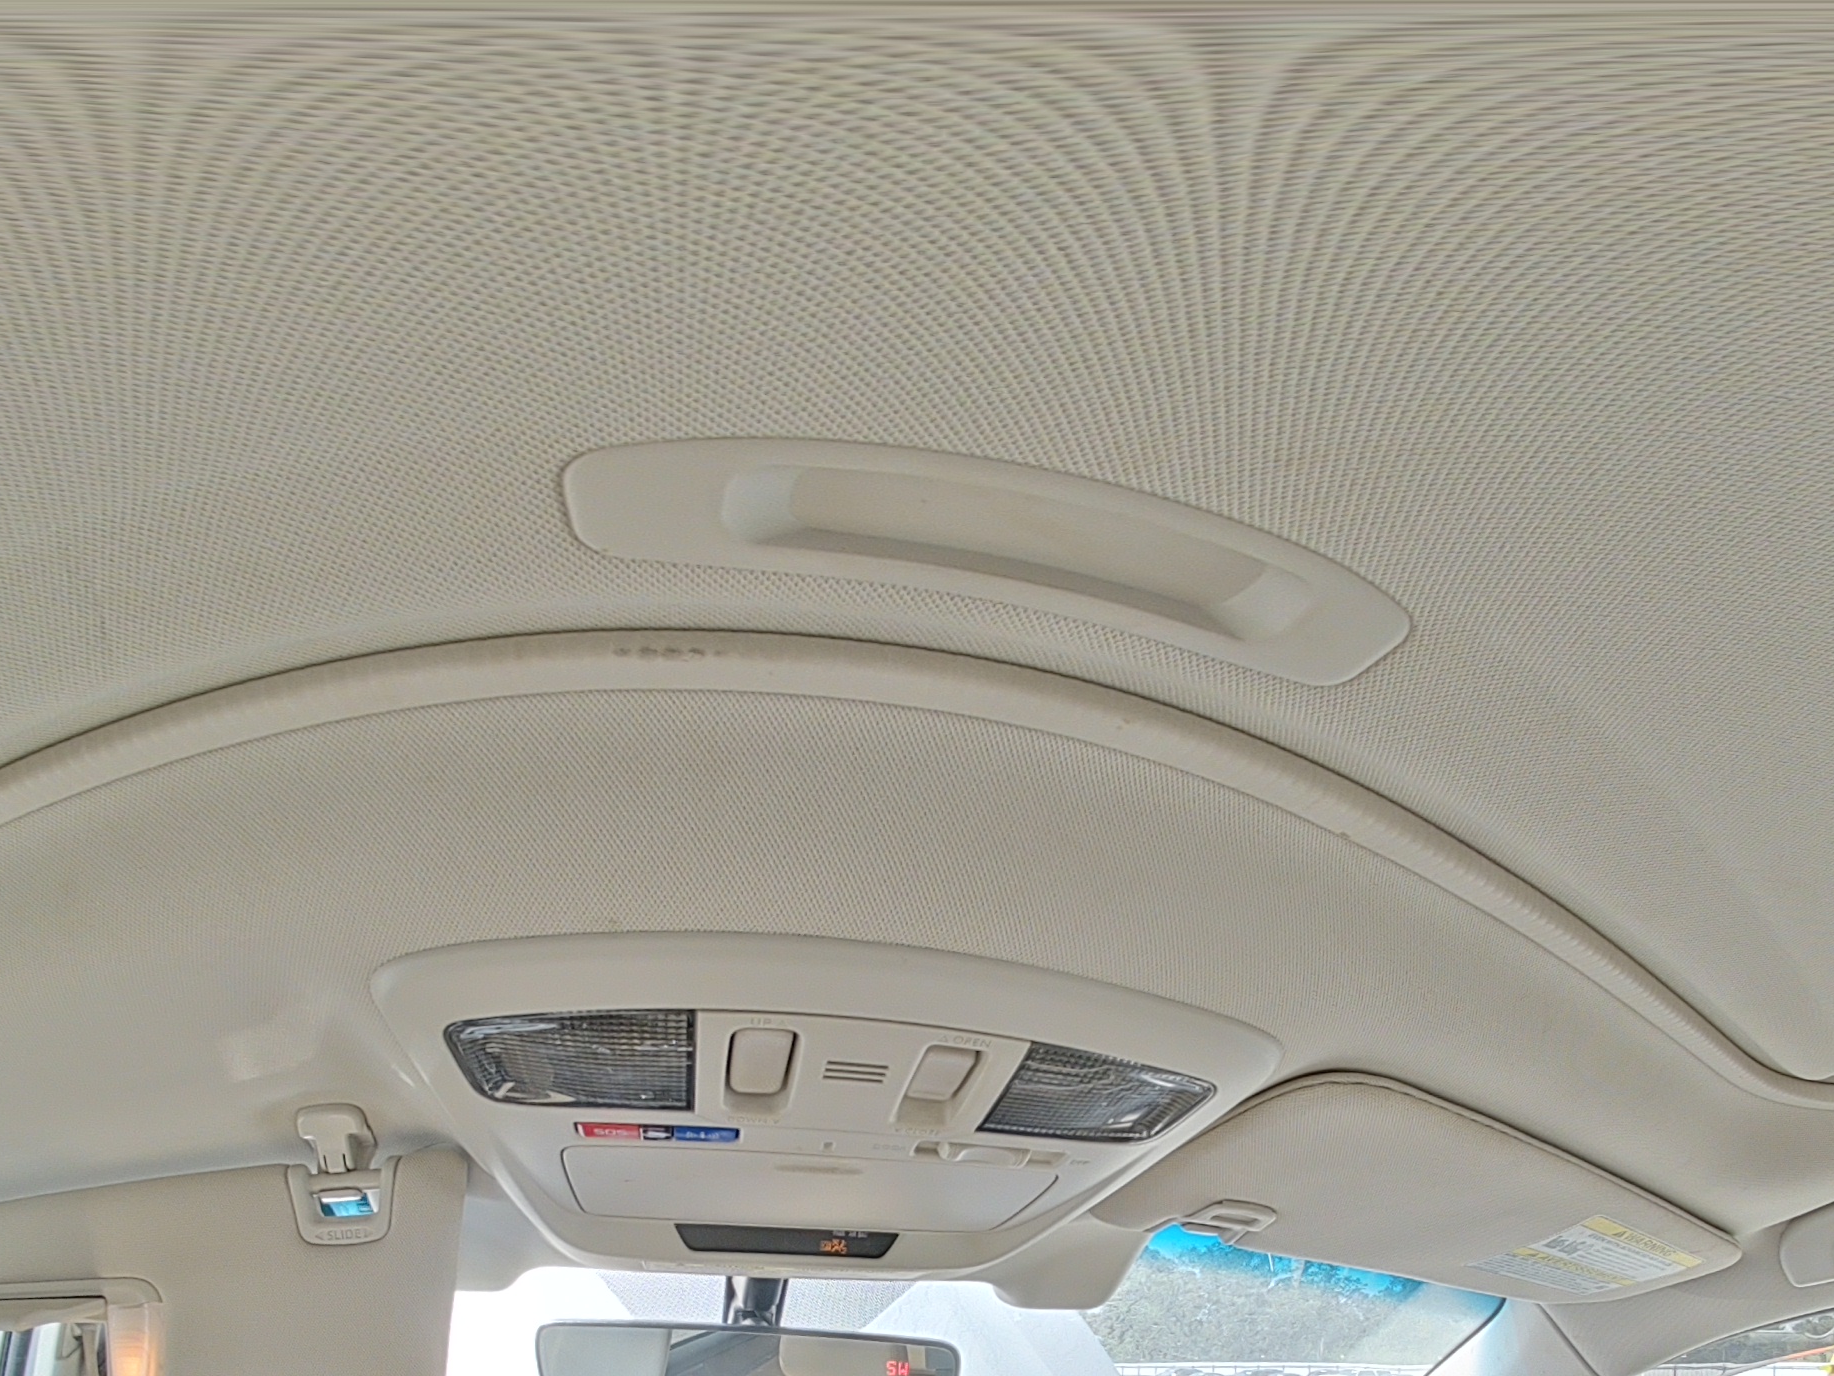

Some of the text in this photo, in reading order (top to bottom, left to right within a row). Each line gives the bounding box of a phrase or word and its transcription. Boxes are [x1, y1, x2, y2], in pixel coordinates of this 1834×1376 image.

[953, 1034, 992, 1049] OPEN
[592, 1126, 628, 1137] SOS
[326, 1228, 363, 1242] SLIDE
[1624, 1231, 1678, 1259] WARNING
[886, 1360, 911, 1376] SW
